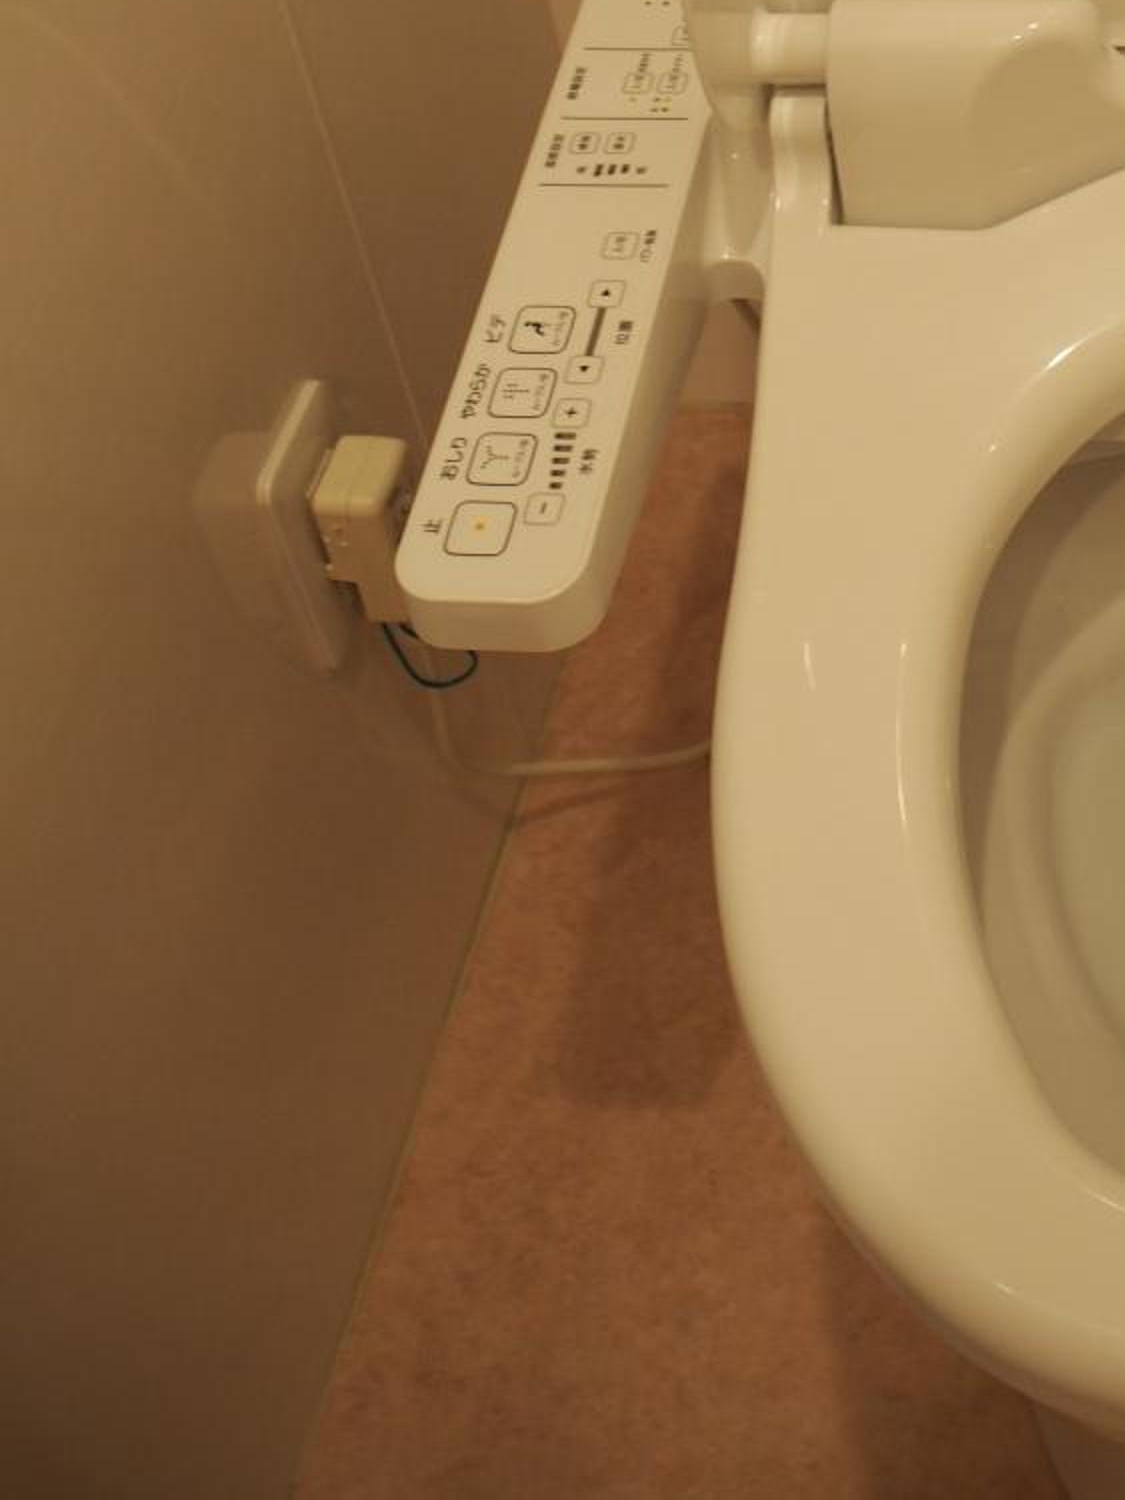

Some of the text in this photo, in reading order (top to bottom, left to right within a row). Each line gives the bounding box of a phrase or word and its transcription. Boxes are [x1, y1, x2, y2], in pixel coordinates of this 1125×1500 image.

[460, 363, 492, 420] やわらか
[439, 436, 469, 481] おしり
